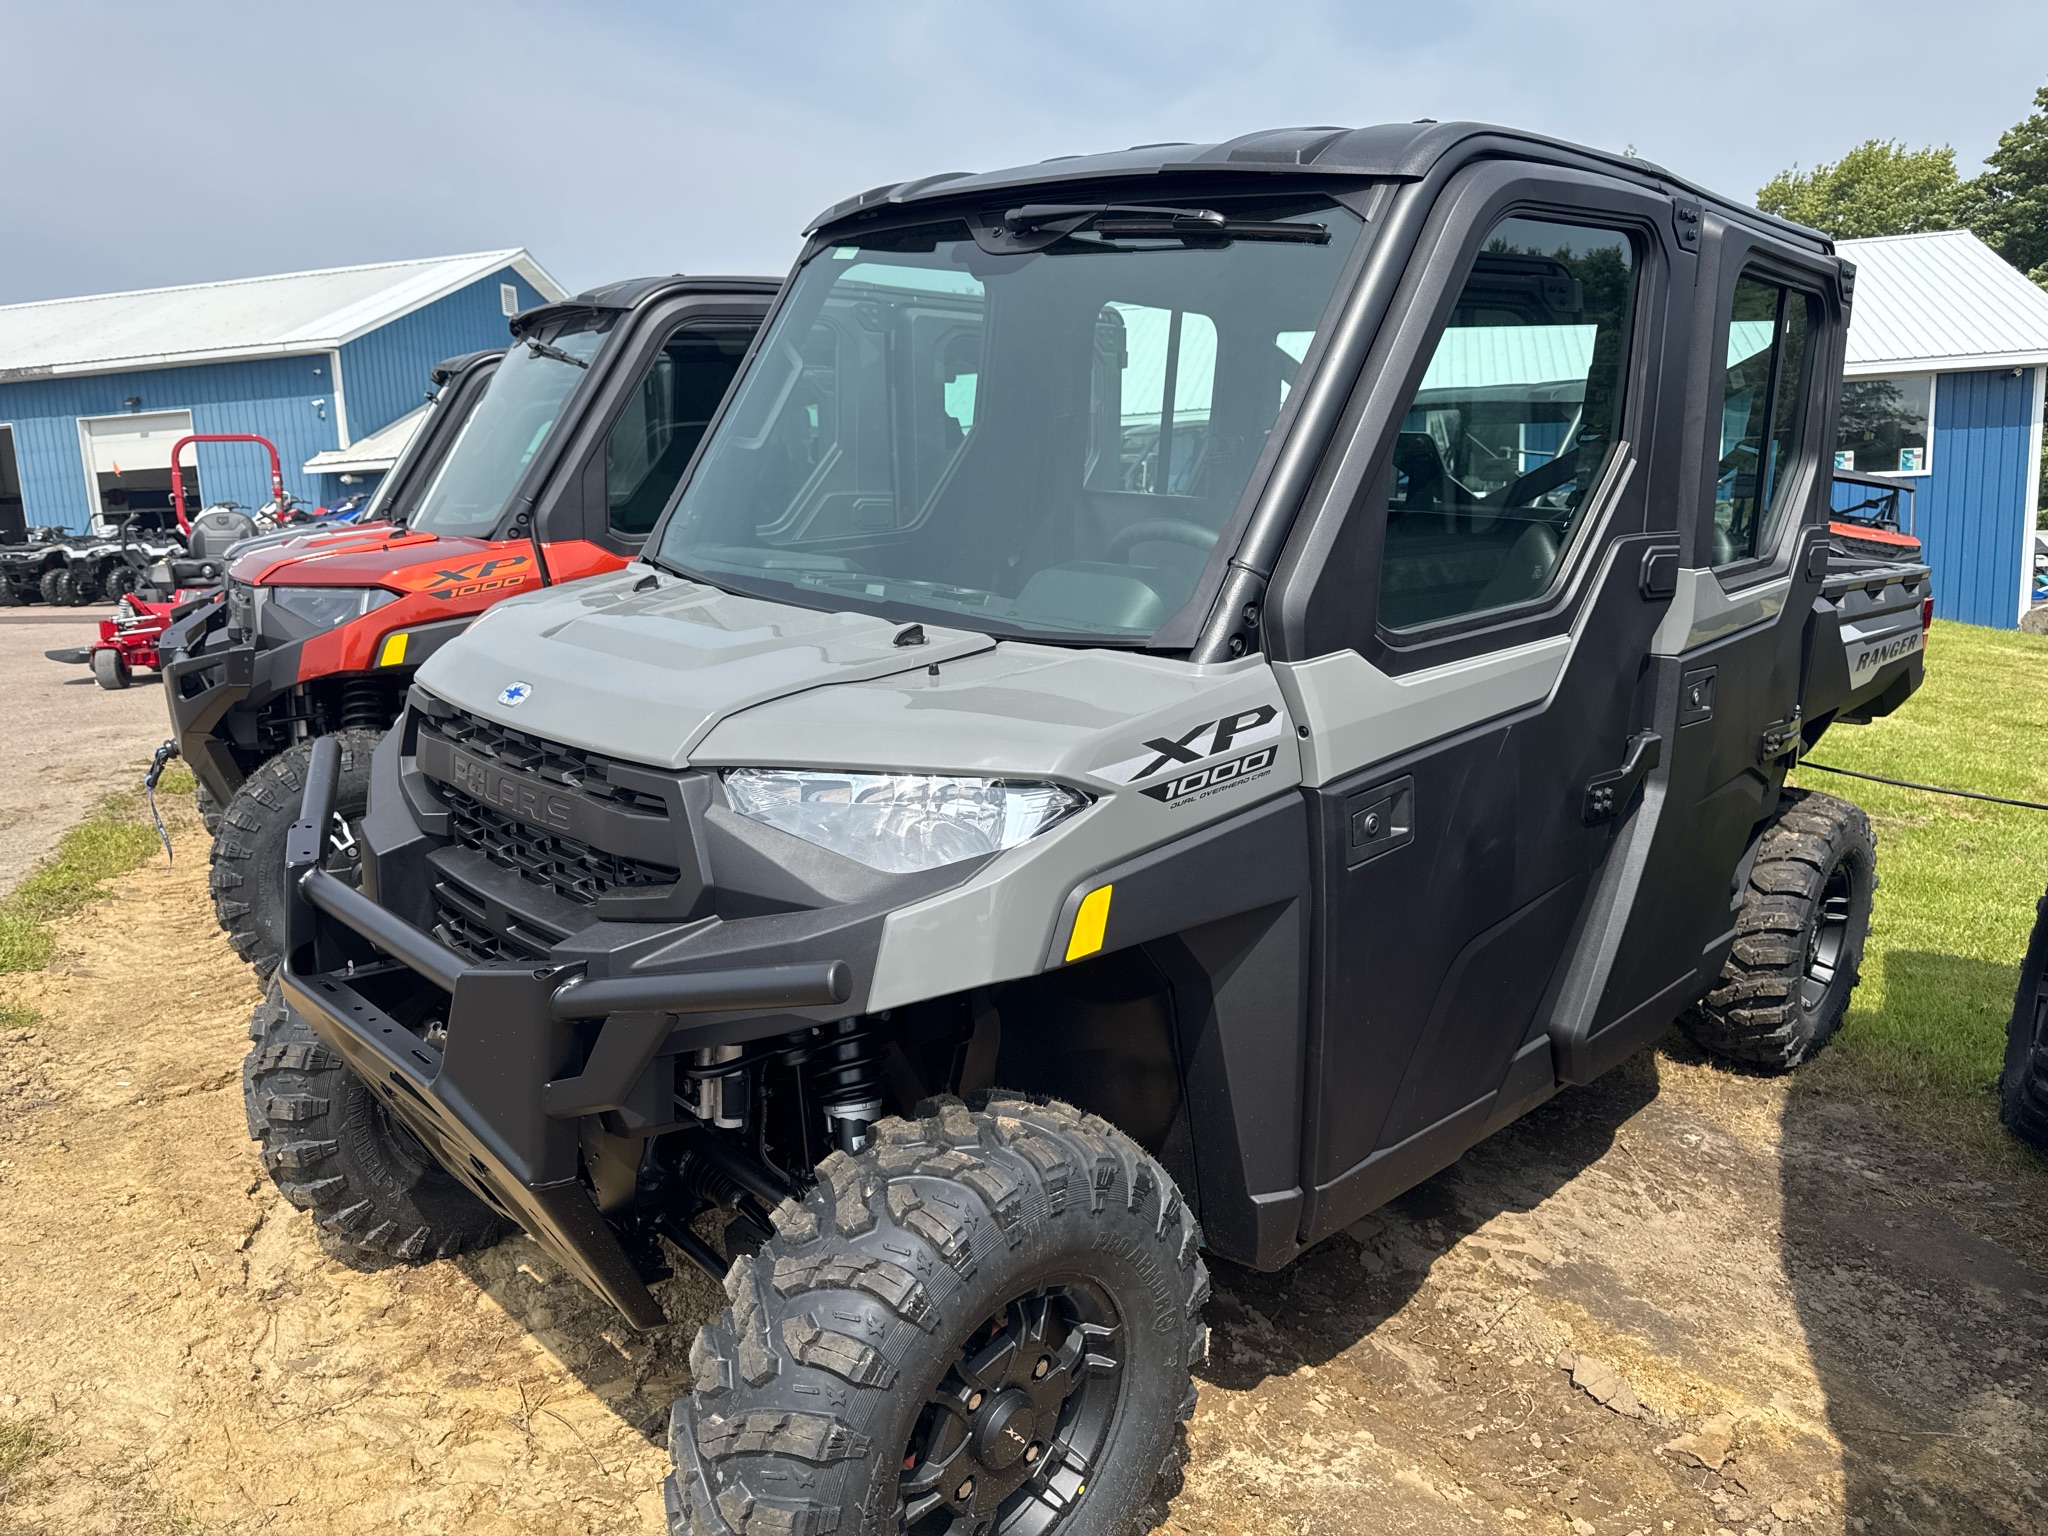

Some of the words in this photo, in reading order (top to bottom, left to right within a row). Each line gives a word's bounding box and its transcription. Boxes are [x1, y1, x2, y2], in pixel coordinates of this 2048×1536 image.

[425, 555, 529, 588] XP
[450, 575, 525, 598] 1000
[1856, 634, 1918, 672] RANGER
[1128, 704, 1278, 783] XP
[453, 755, 571, 830] POLARIS
[1165, 750, 1270, 800] 1000
[1170, 797, 1197, 810] DUAL
[1200, 777, 1250, 800] OVERHEAD
[1251, 769, 1271, 781] CAM
[1091, 1231, 1131, 1258] PRO
[1126, 1244, 1172, 1311] ARMOR
[1002, 1424, 1026, 1444] XP
